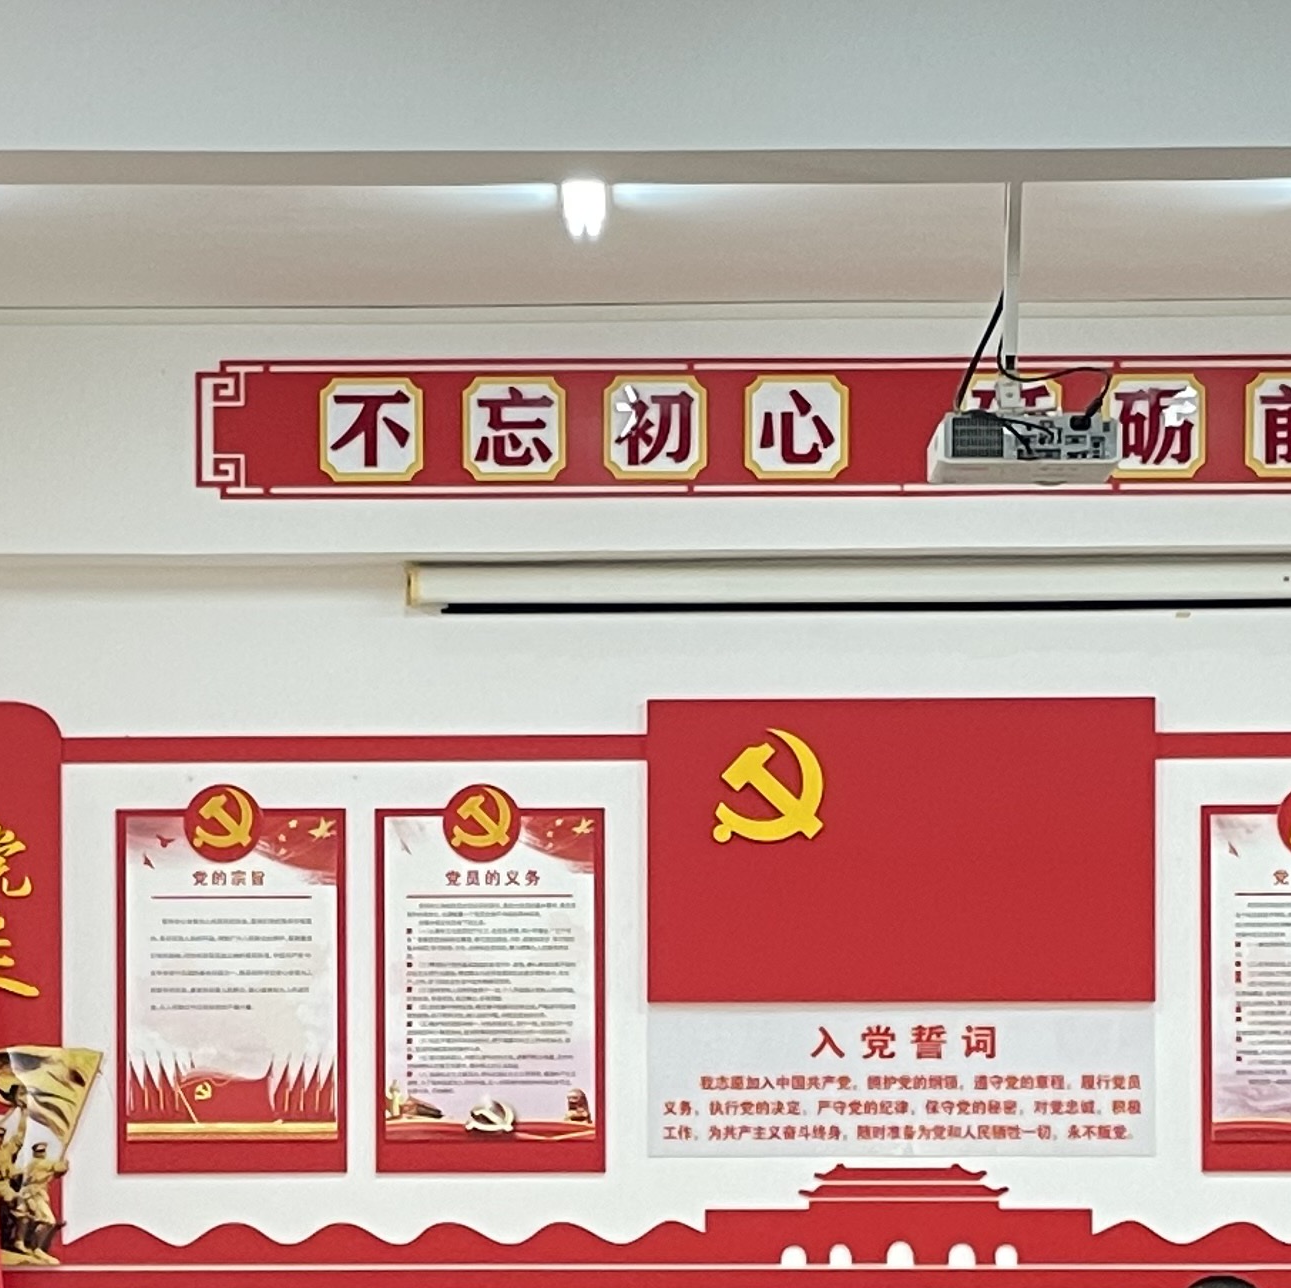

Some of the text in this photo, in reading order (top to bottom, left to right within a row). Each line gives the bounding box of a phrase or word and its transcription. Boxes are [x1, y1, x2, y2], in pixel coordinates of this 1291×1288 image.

[330, 385, 836, 468] 不忘初心
[192, 869, 266, 886] 党的宗旨
[444, 869, 541, 886] 党员的义务
[811, 1024, 998, 1060] 入党誓词
